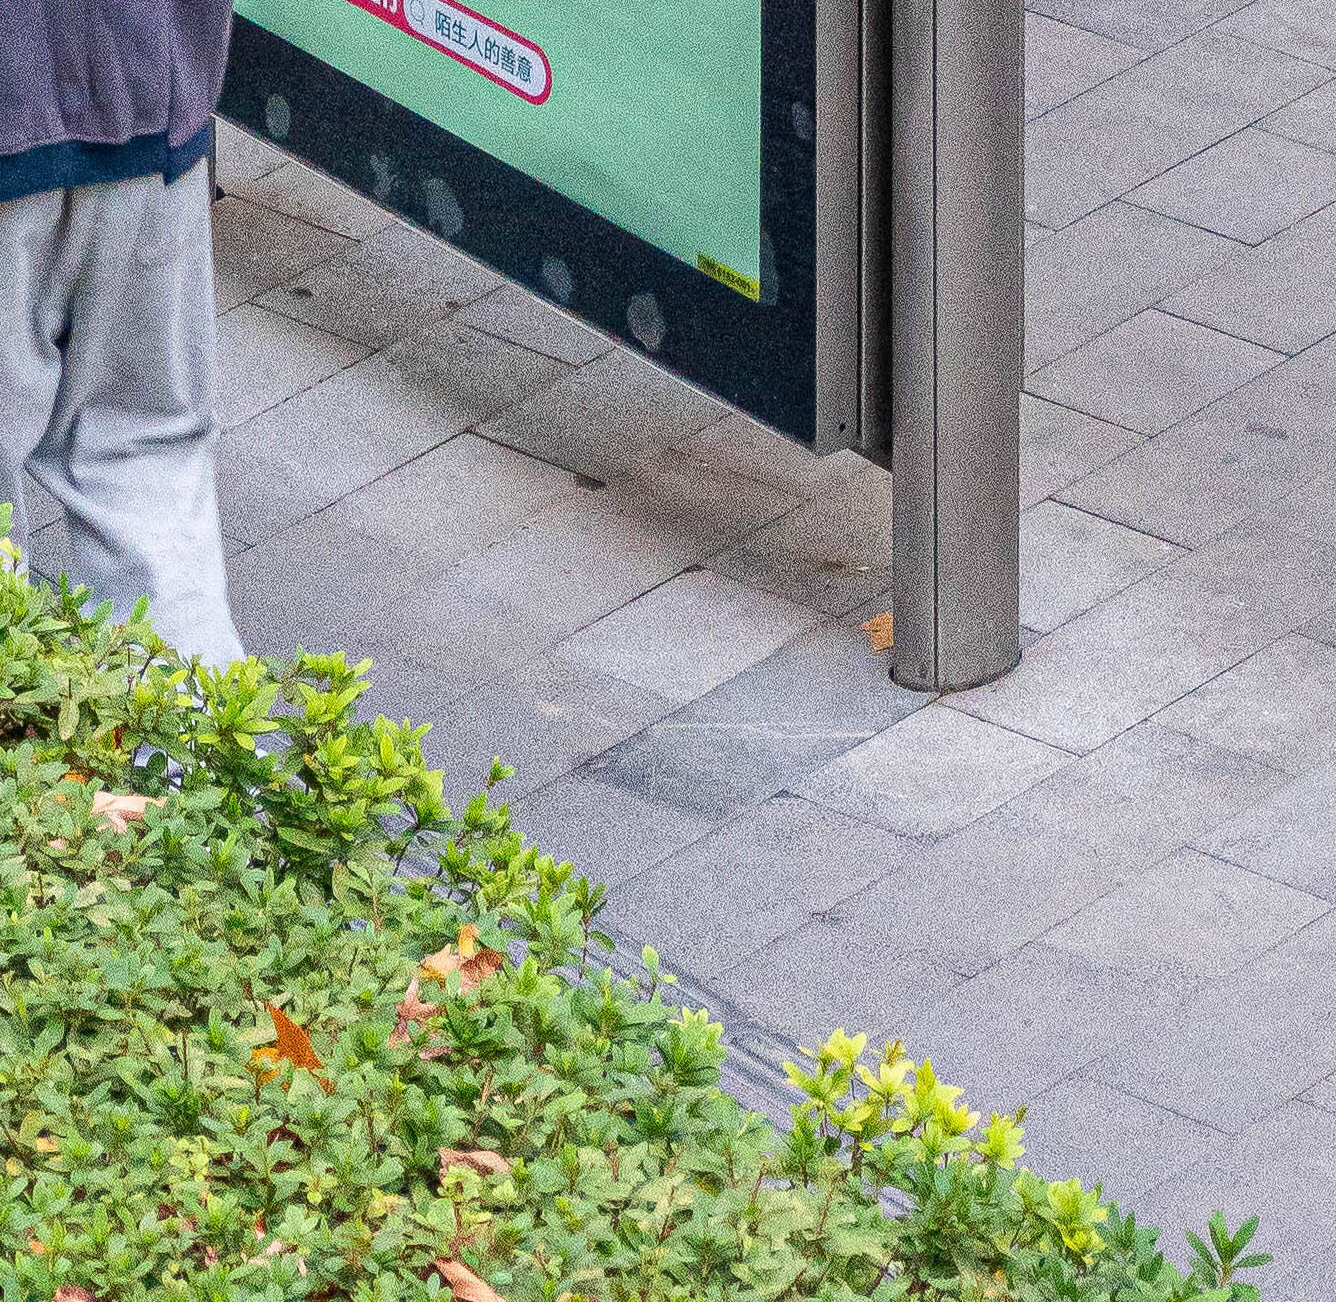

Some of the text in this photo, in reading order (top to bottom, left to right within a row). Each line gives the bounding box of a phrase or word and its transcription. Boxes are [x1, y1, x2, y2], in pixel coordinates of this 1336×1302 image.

[434, 9, 533, 84] 陌生人的善意
